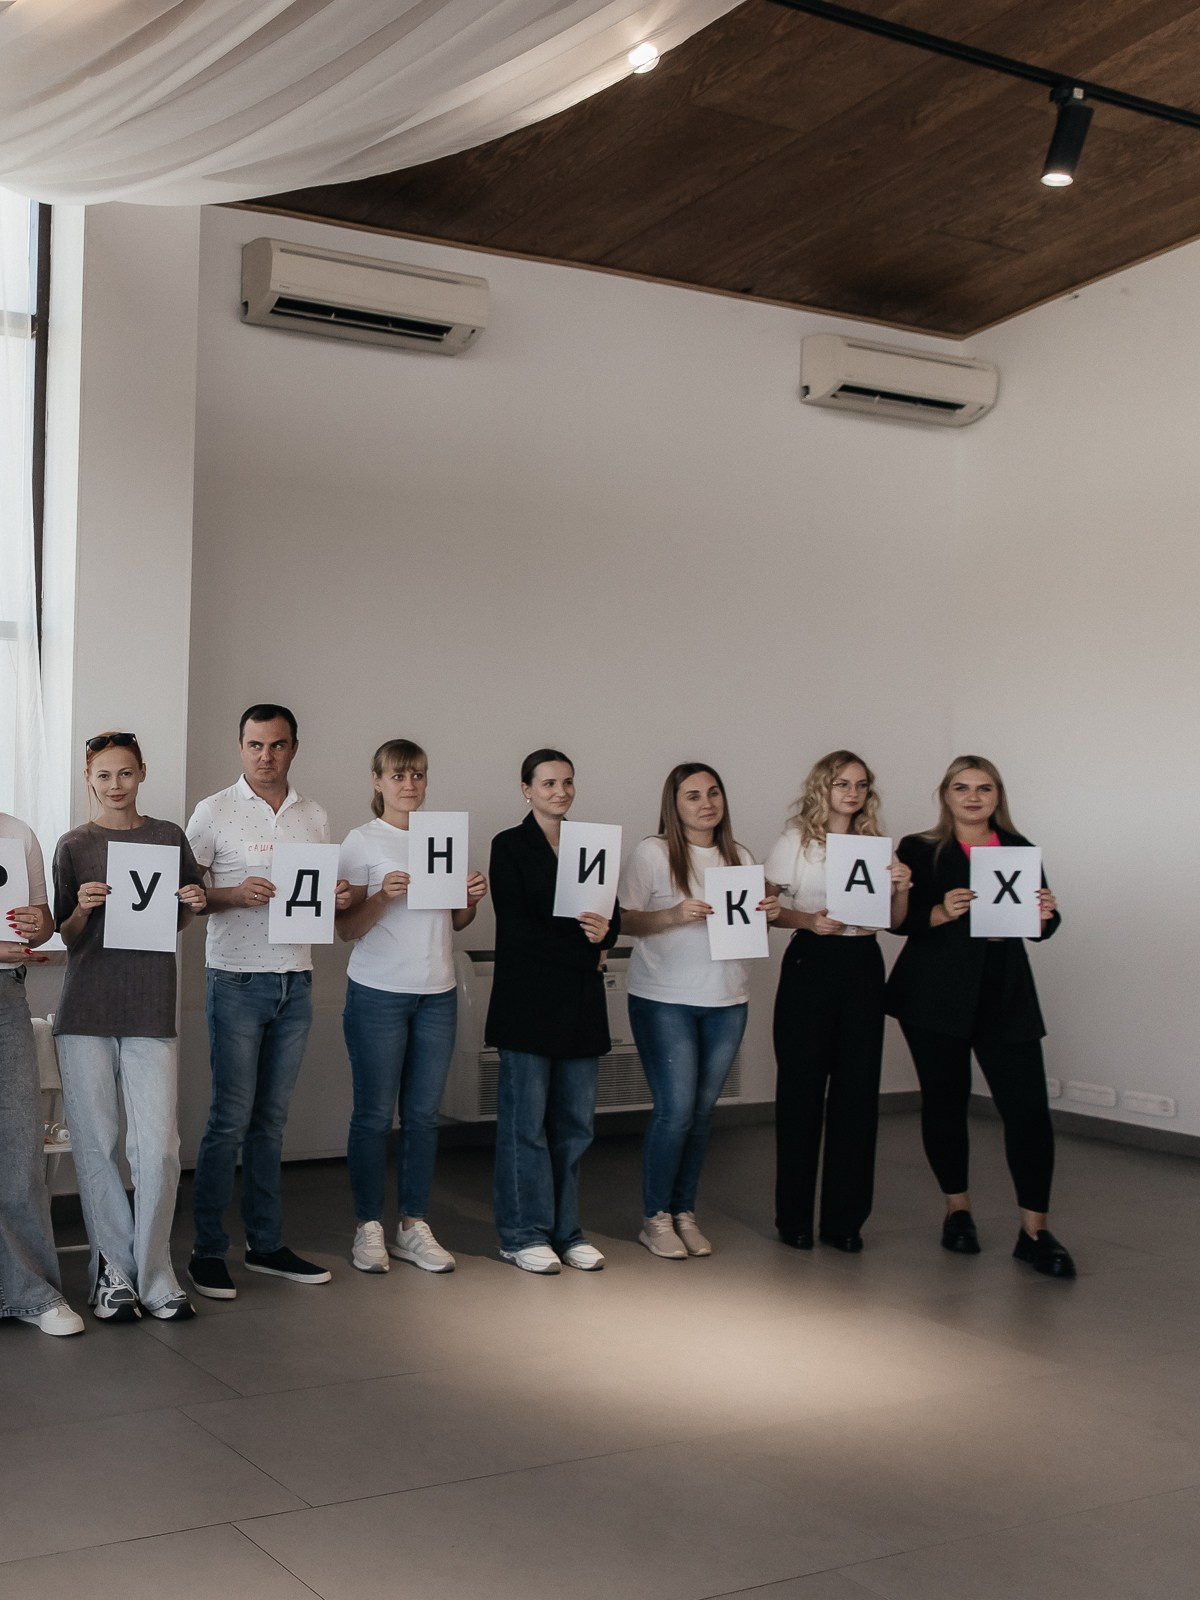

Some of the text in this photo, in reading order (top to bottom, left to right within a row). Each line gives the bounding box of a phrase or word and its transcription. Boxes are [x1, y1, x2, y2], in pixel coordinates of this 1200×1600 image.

[428, 837, 453, 874] Н
[578, 847, 606, 885] И
[129, 870, 161, 911] У
[286, 869, 321, 917] Д
[845, 859, 875, 894] А
[993, 870, 1021, 904] Х
[726, 890, 750, 925] К
